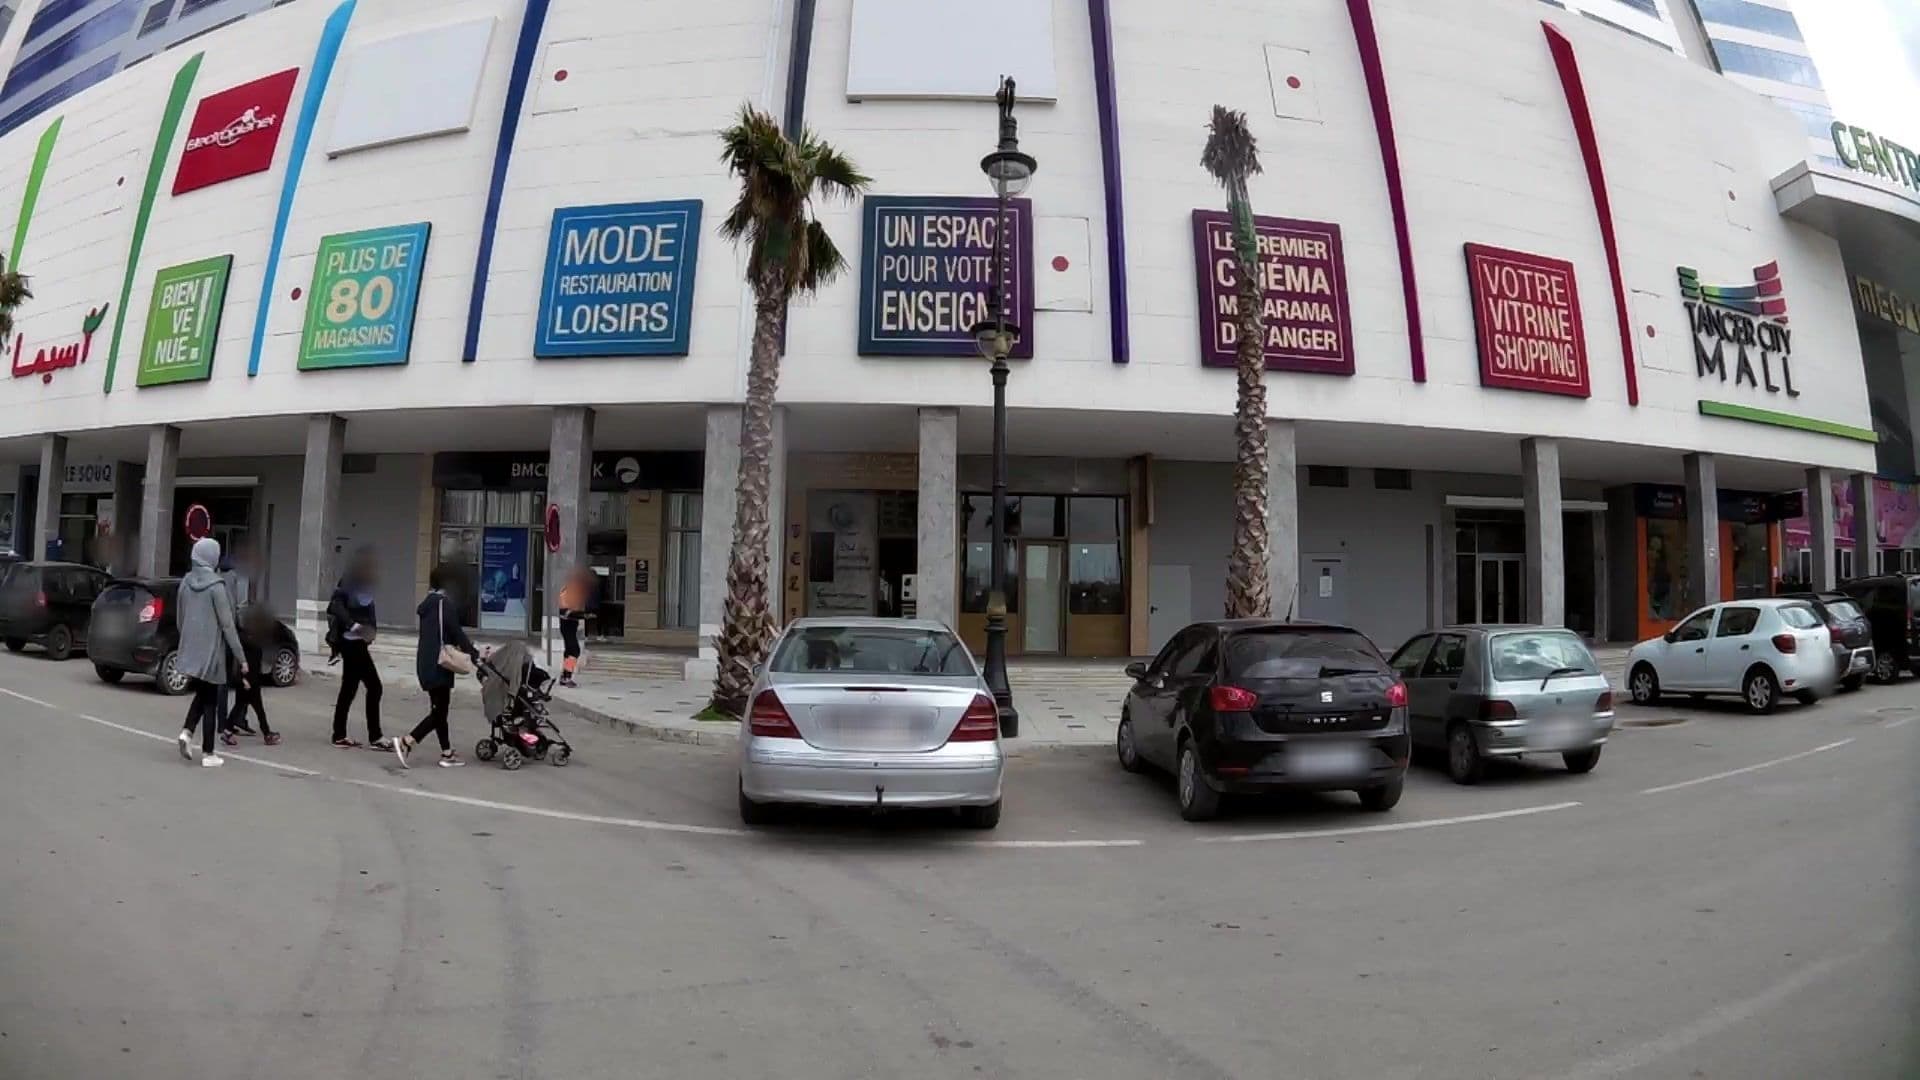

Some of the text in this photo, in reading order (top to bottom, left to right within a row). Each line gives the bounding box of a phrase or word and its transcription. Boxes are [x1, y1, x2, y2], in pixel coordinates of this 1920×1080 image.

[563, 222, 678, 266] MODE
[884, 214, 915, 248] UN
[1255, 234, 1328, 260] REMIER
[326, 242, 411, 277] PLUS DE
[882, 254, 938, 283] POUR
[161, 278, 199, 309] BIEN
[326, 275, 394, 324] 80
[559, 271, 673, 296] RESTAURATION
[1482, 263, 1568, 306] VOTRE
[173, 307, 194, 334] VE
[554, 302, 669, 334] LOISIRS
[1219, 294, 1334, 323] MARAMA
[1488, 297, 1572, 341] VITRINE
[314, 324, 395, 349] MAGASINS
[1683, 301, 1791, 355] TANGER CITY
[1494, 333, 1577, 377] SHOPPING
[1693, 333, 1801, 398] MALL
[79, 464, 112, 482] SOUQ
